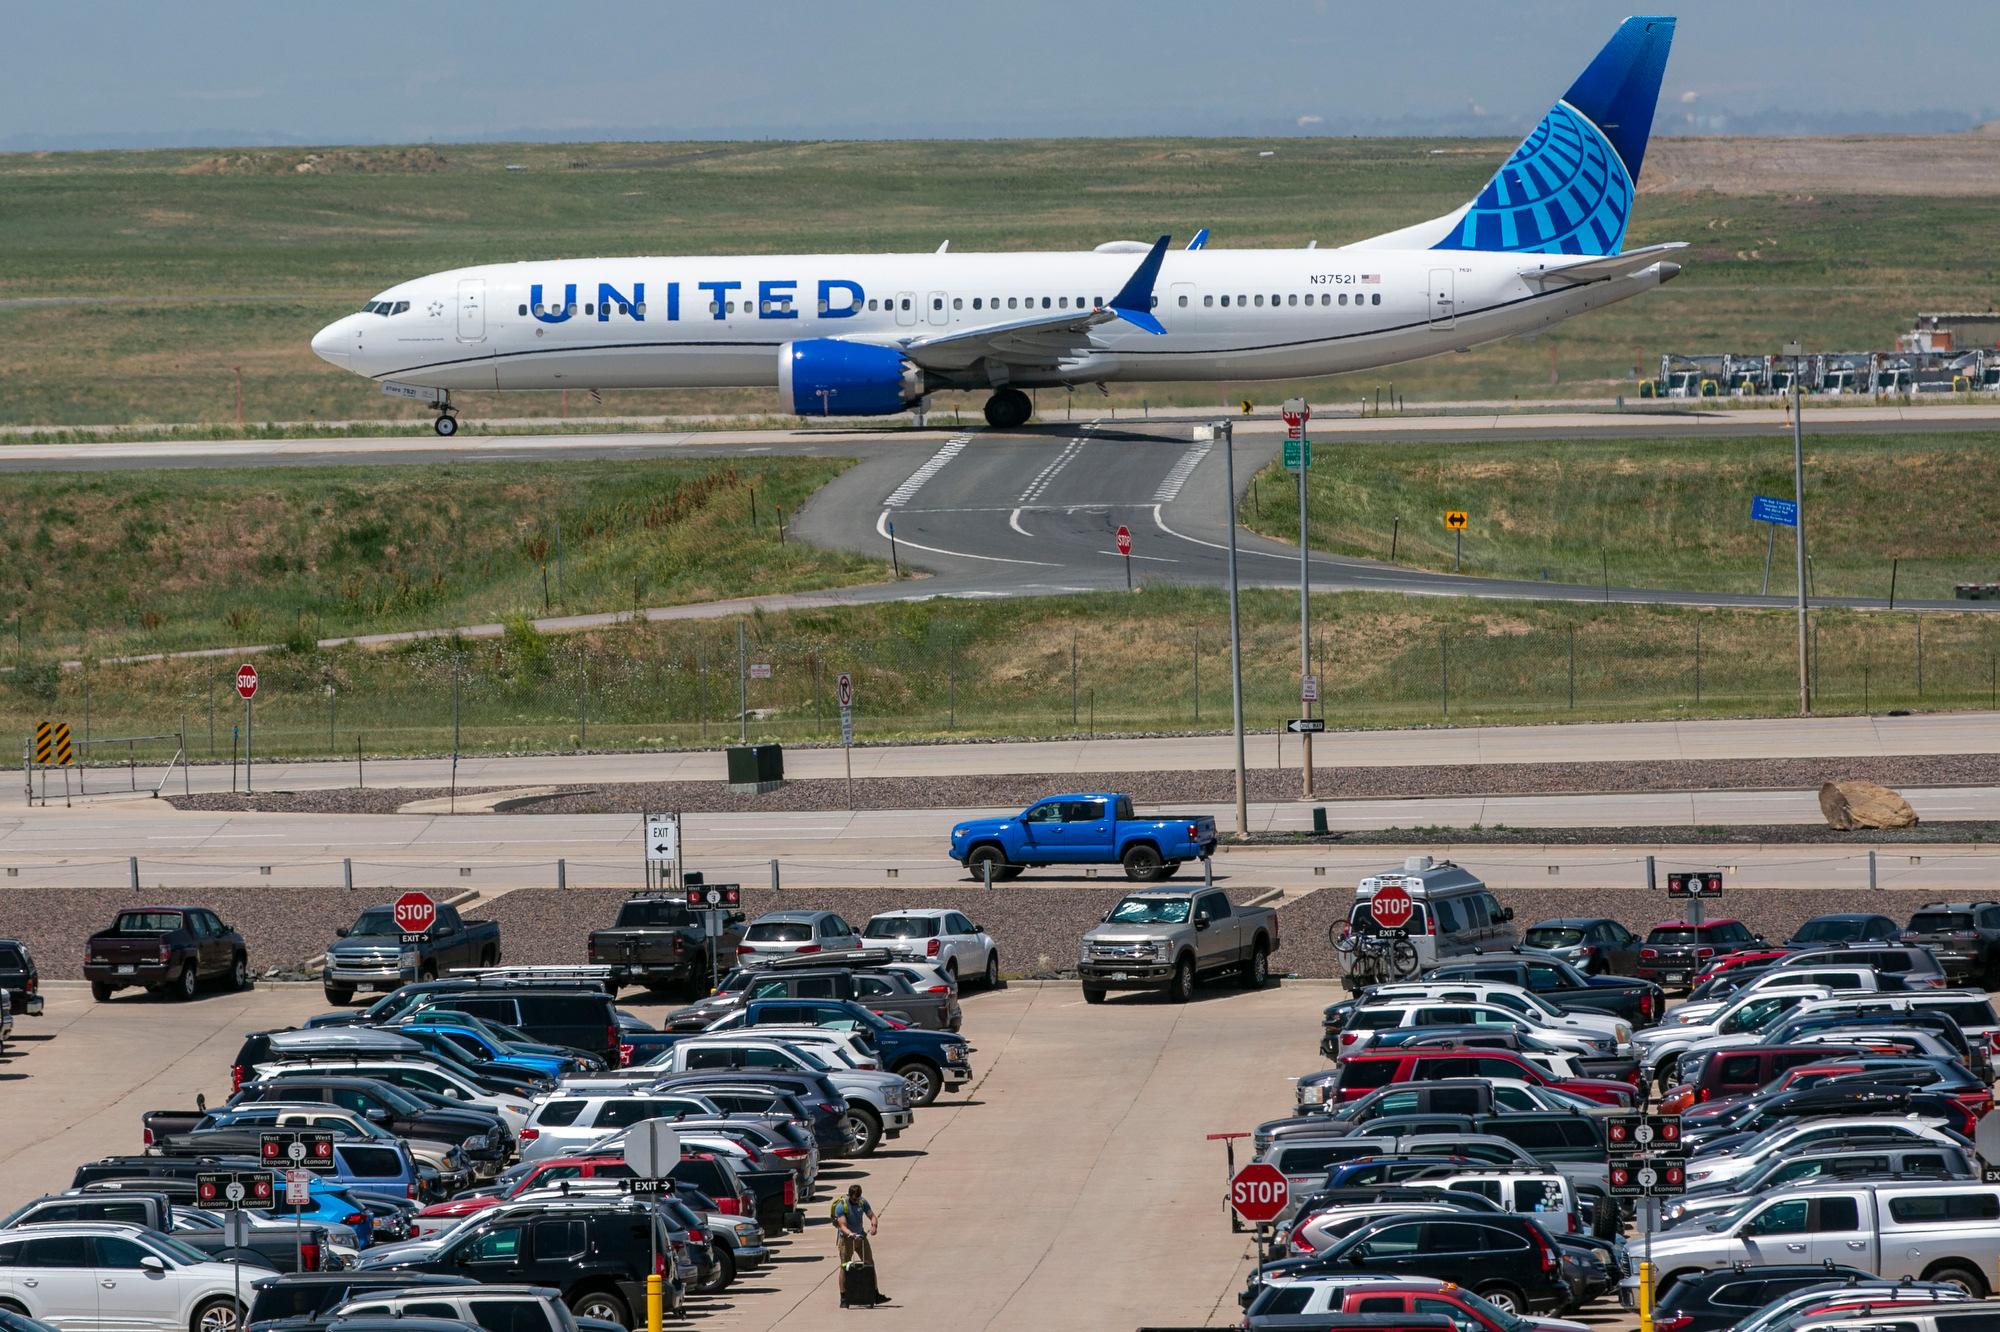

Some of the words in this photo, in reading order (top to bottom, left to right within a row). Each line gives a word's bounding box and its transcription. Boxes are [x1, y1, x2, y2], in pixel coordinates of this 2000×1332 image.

[1310, 275, 1356, 284] N37521
[530, 279, 865, 324] UNITED
[1117, 534, 1131, 547] STOP
[238, 675, 256, 688] STOP
[653, 827, 669, 838] EXIT
[1672, 881, 1679, 889] K
[1712, 881, 1717, 889] J
[691, 893, 697, 901] L
[729, 892, 736, 900] K
[1374, 898, 1409, 914] STOP
[397, 904, 433, 920] STOP
[402, 934, 420, 942] EXIT
[1379, 929, 1397, 937] EXIT
[1613, 1129, 1621, 1138] K
[1641, 1131, 1648, 1140] 3
[1668, 1127, 1673, 1137] J
[267, 1145, 274, 1155] L
[294, 1148, 301, 1158] 3
[319, 1145, 327, 1154] K
[1615, 1172, 1624, 1182] K
[1644, 1174, 1651, 1184] 2
[1672, 1171, 1678, 1181] J
[258, 1185, 266, 1195] K
[635, 1181, 658, 1191] EXIT
[204, 1186, 212, 1197] L
[232, 1189, 239, 1199] 2
[1234, 1181, 1286, 1203] STOP
